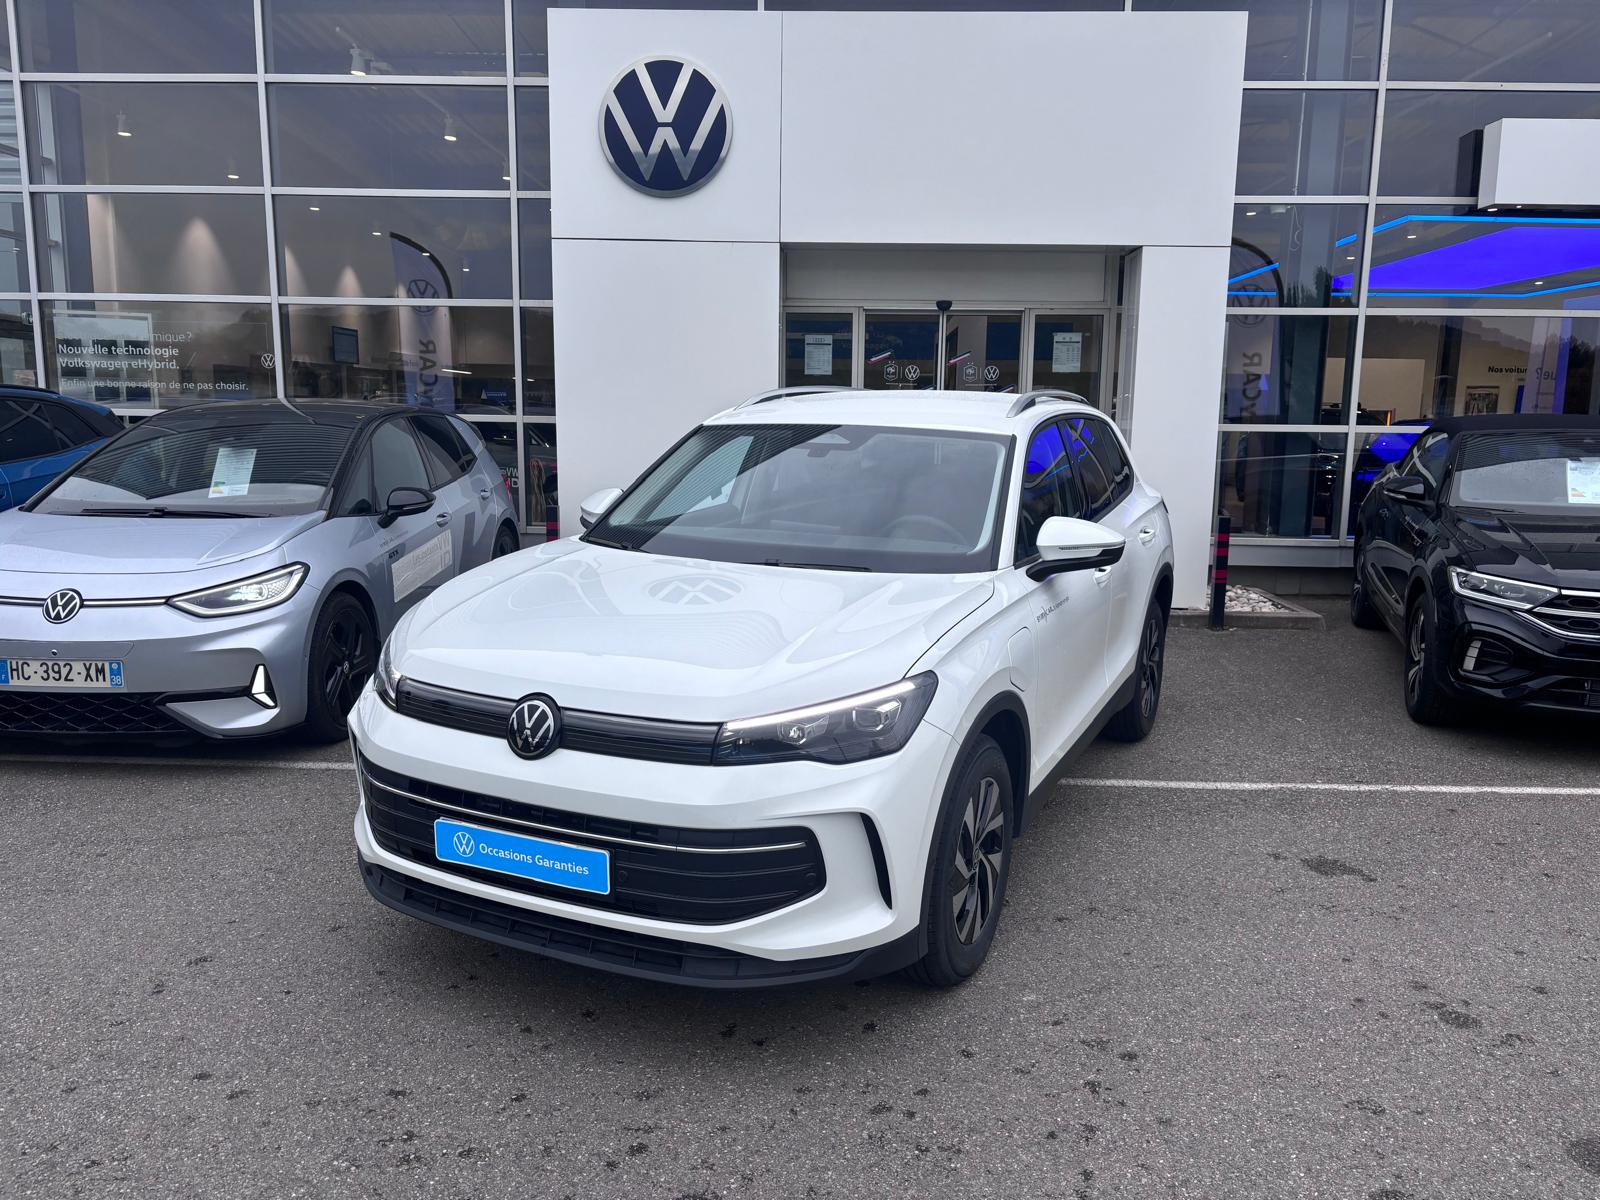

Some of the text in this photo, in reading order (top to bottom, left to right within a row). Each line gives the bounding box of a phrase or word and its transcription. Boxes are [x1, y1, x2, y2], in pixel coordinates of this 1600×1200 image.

[58, 344, 180, 357] Nouvelle technologie
[59, 357, 180, 371] Volkswagen eHybrid.
[1488, 365, 1528, 374] Nos voitur
[61, 378, 249, 391] Enfin une bonne raison de ne pas choisir.
[9, 661, 107, 682] HC-392-XM
[111, 675, 122, 685] 38
[479, 843, 534, 864] Occasions
[534, 854, 590, 875] Garanties
